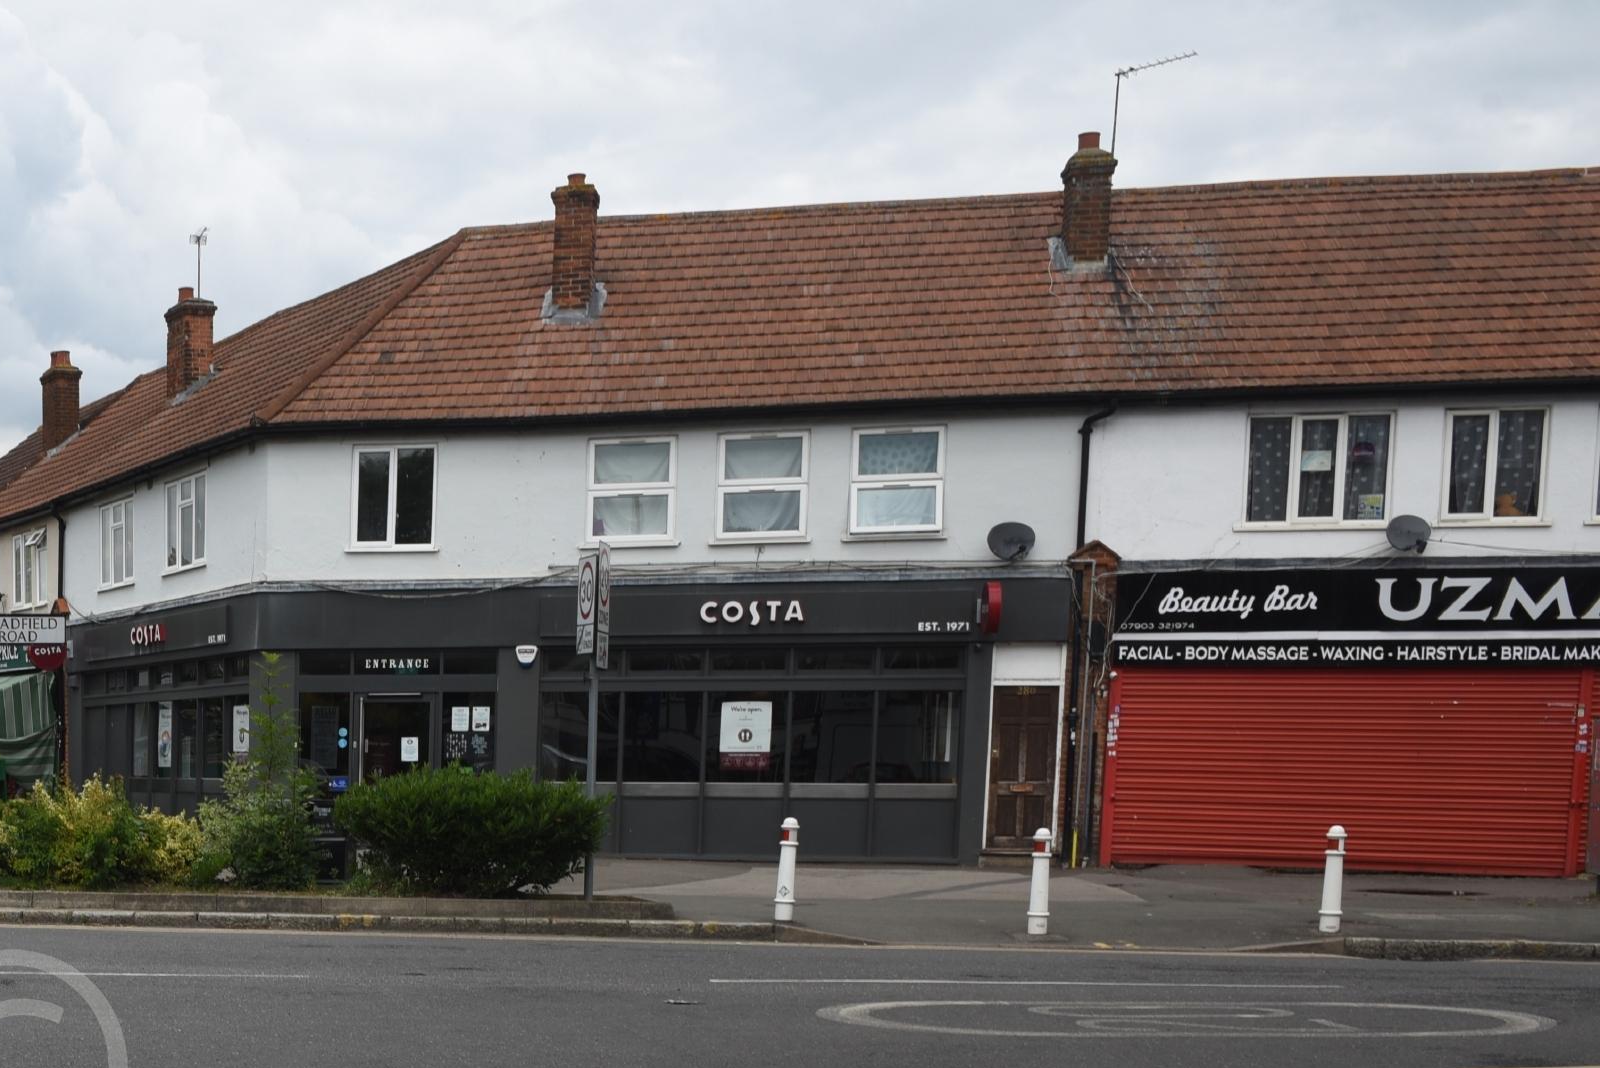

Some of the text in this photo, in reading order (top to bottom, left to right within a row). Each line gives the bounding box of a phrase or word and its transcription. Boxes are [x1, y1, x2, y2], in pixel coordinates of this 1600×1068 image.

[581, 579, 592, 603] 30
[1158, 585, 1318, 619] Beauty Bar
[700, 600, 804, 626] COSTA
[918, 622, 970, 631] EST. 1971
[1120, 621, 1195, 630] 07903 321974
[130, 623, 161, 646] COSTA
[34, 645, 62, 656] COSTA
[1118, 645, 1174, 661] FACIAL
[1184, 645, 1229, 661] BODY
[1231, 645, 1310, 661] MASSAGE
[1320, 645, 1384, 661] WAXING
[1396, 645, 1488, 661] HAIRSTYLE
[1501, 645, 1561, 661] BRIDAL
[365, 659, 430, 669] ENTRANCE
